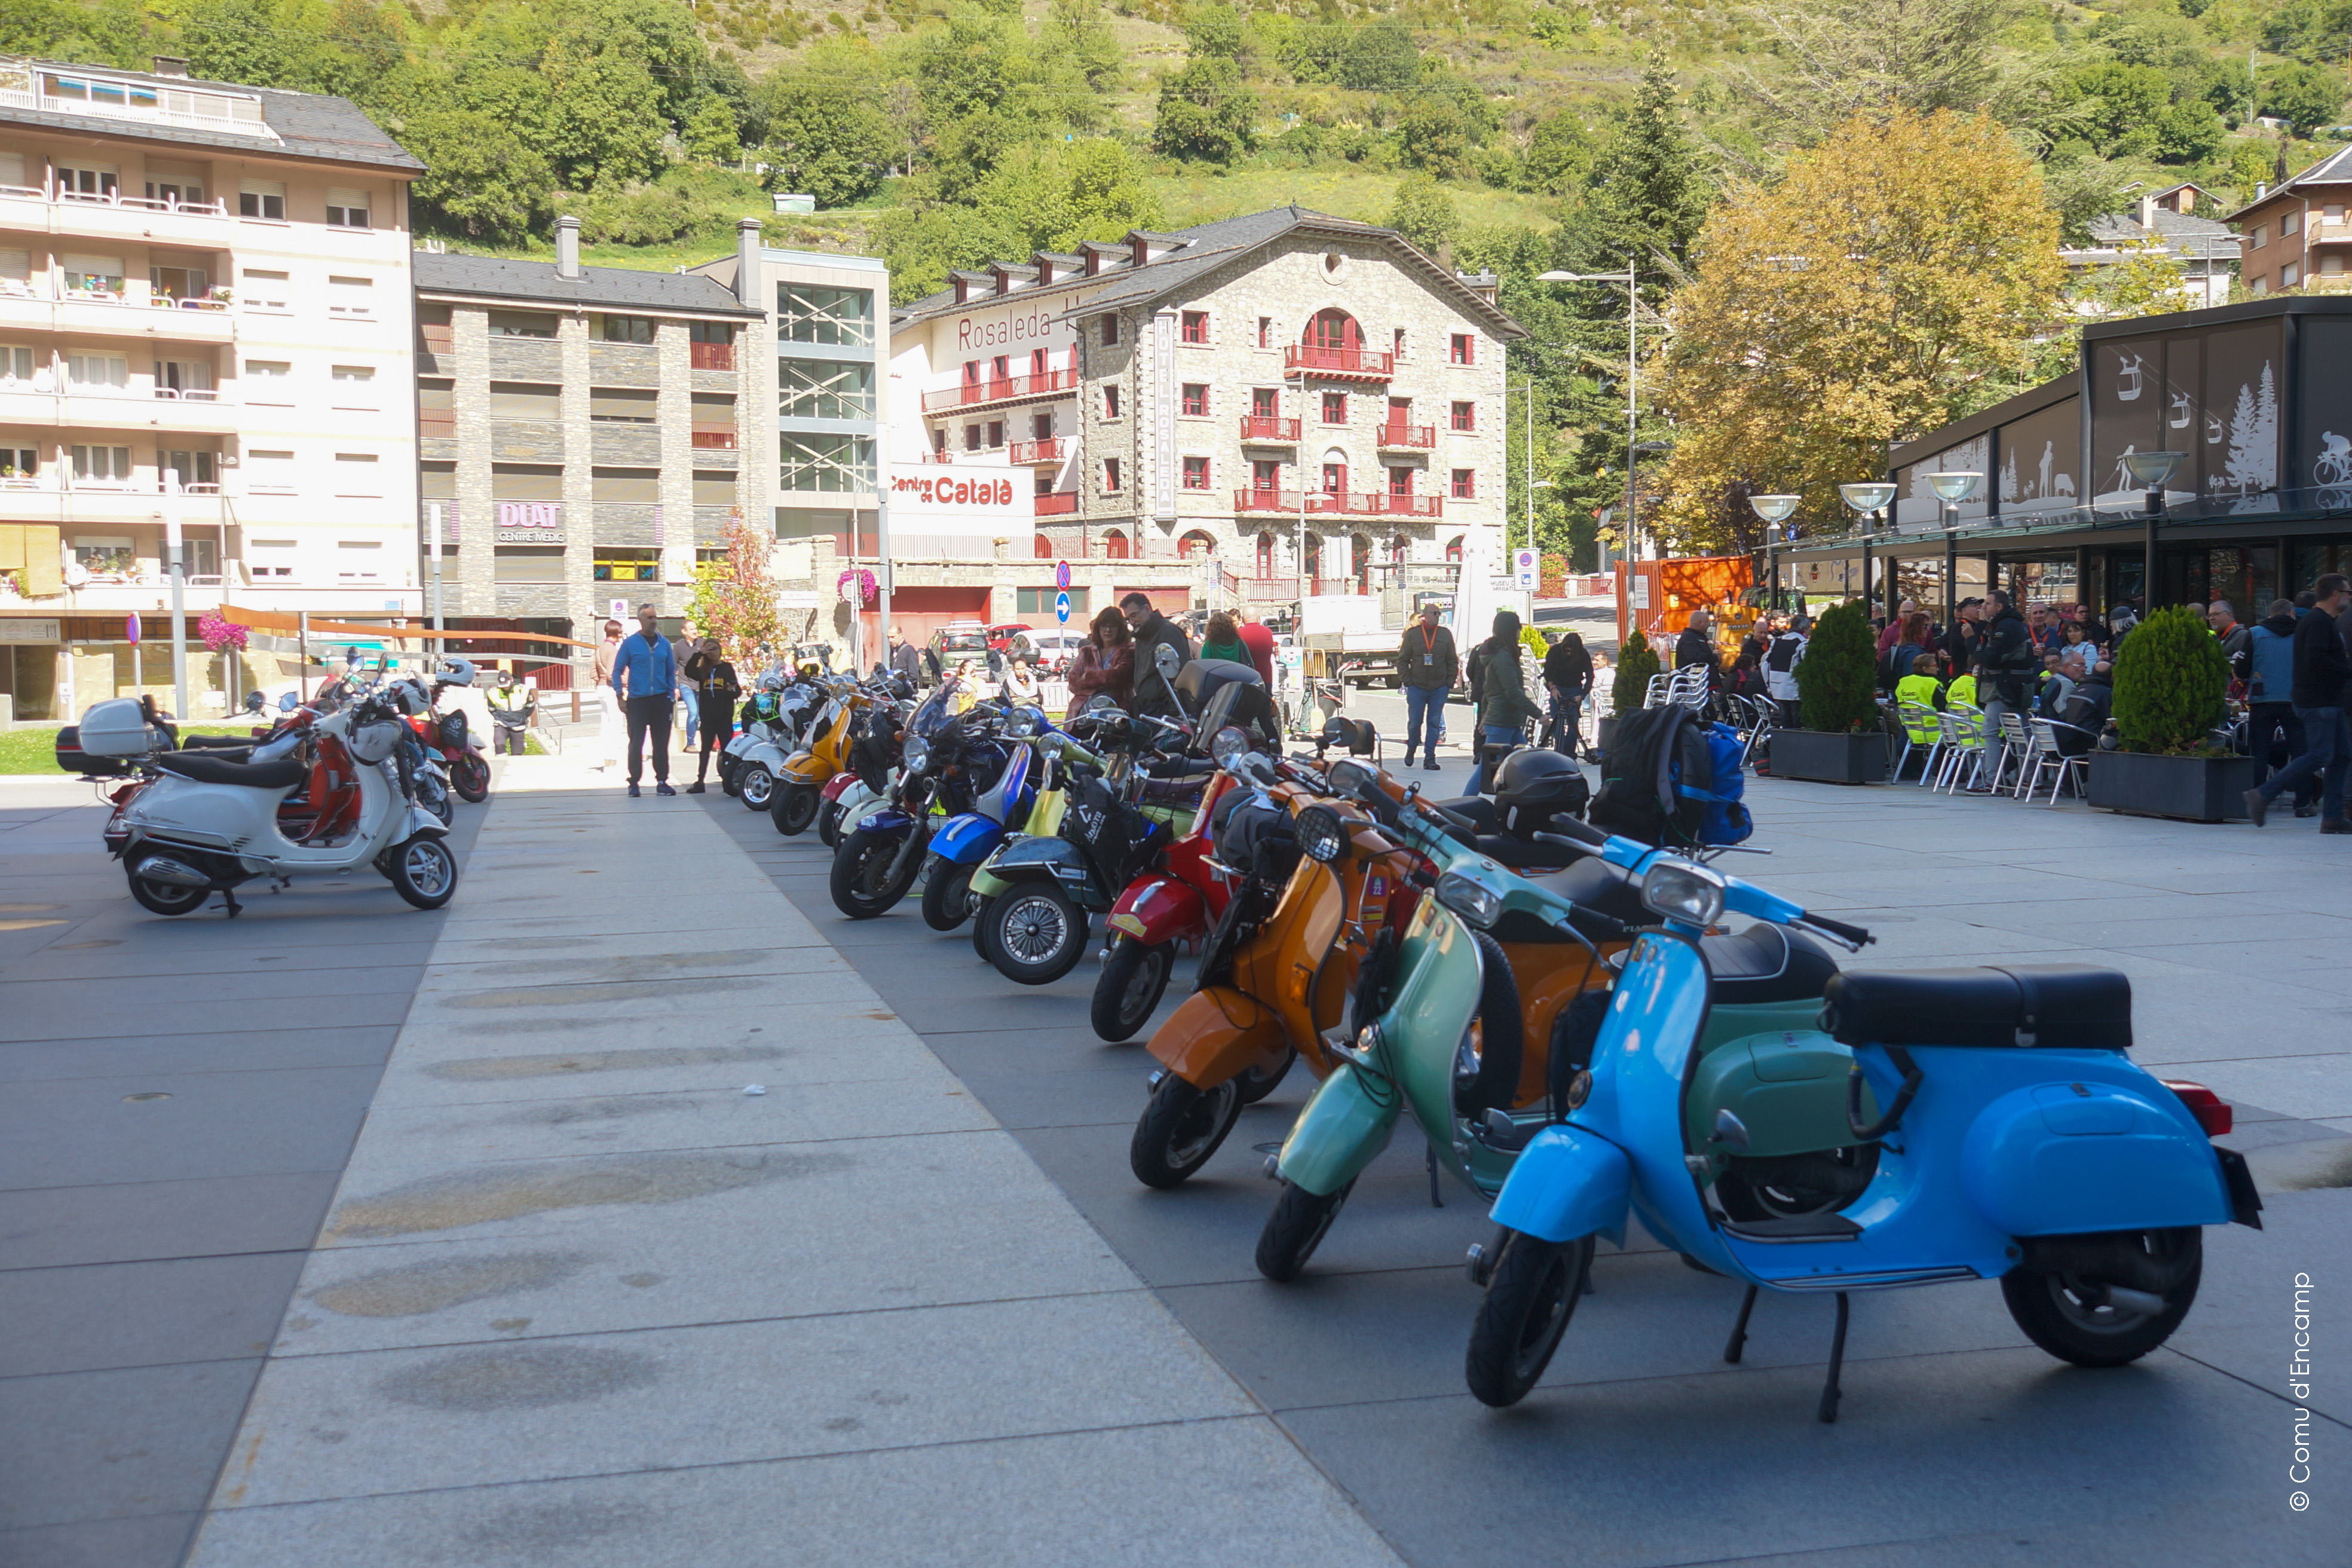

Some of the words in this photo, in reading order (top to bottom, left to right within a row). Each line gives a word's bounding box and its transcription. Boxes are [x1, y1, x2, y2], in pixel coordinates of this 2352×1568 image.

[958, 304, 1051, 352] Rosaleda
[1158, 320, 1169, 399] HOTEL
[1159, 404, 1171, 503] ROSALEDA
[921, 492, 932, 503] de
[935, 477, 1012, 506] Català
[500, 502, 561, 528] DUAT
[499, 532, 533, 542] CENTRE
[535, 531, 565, 543] MÈDIC
